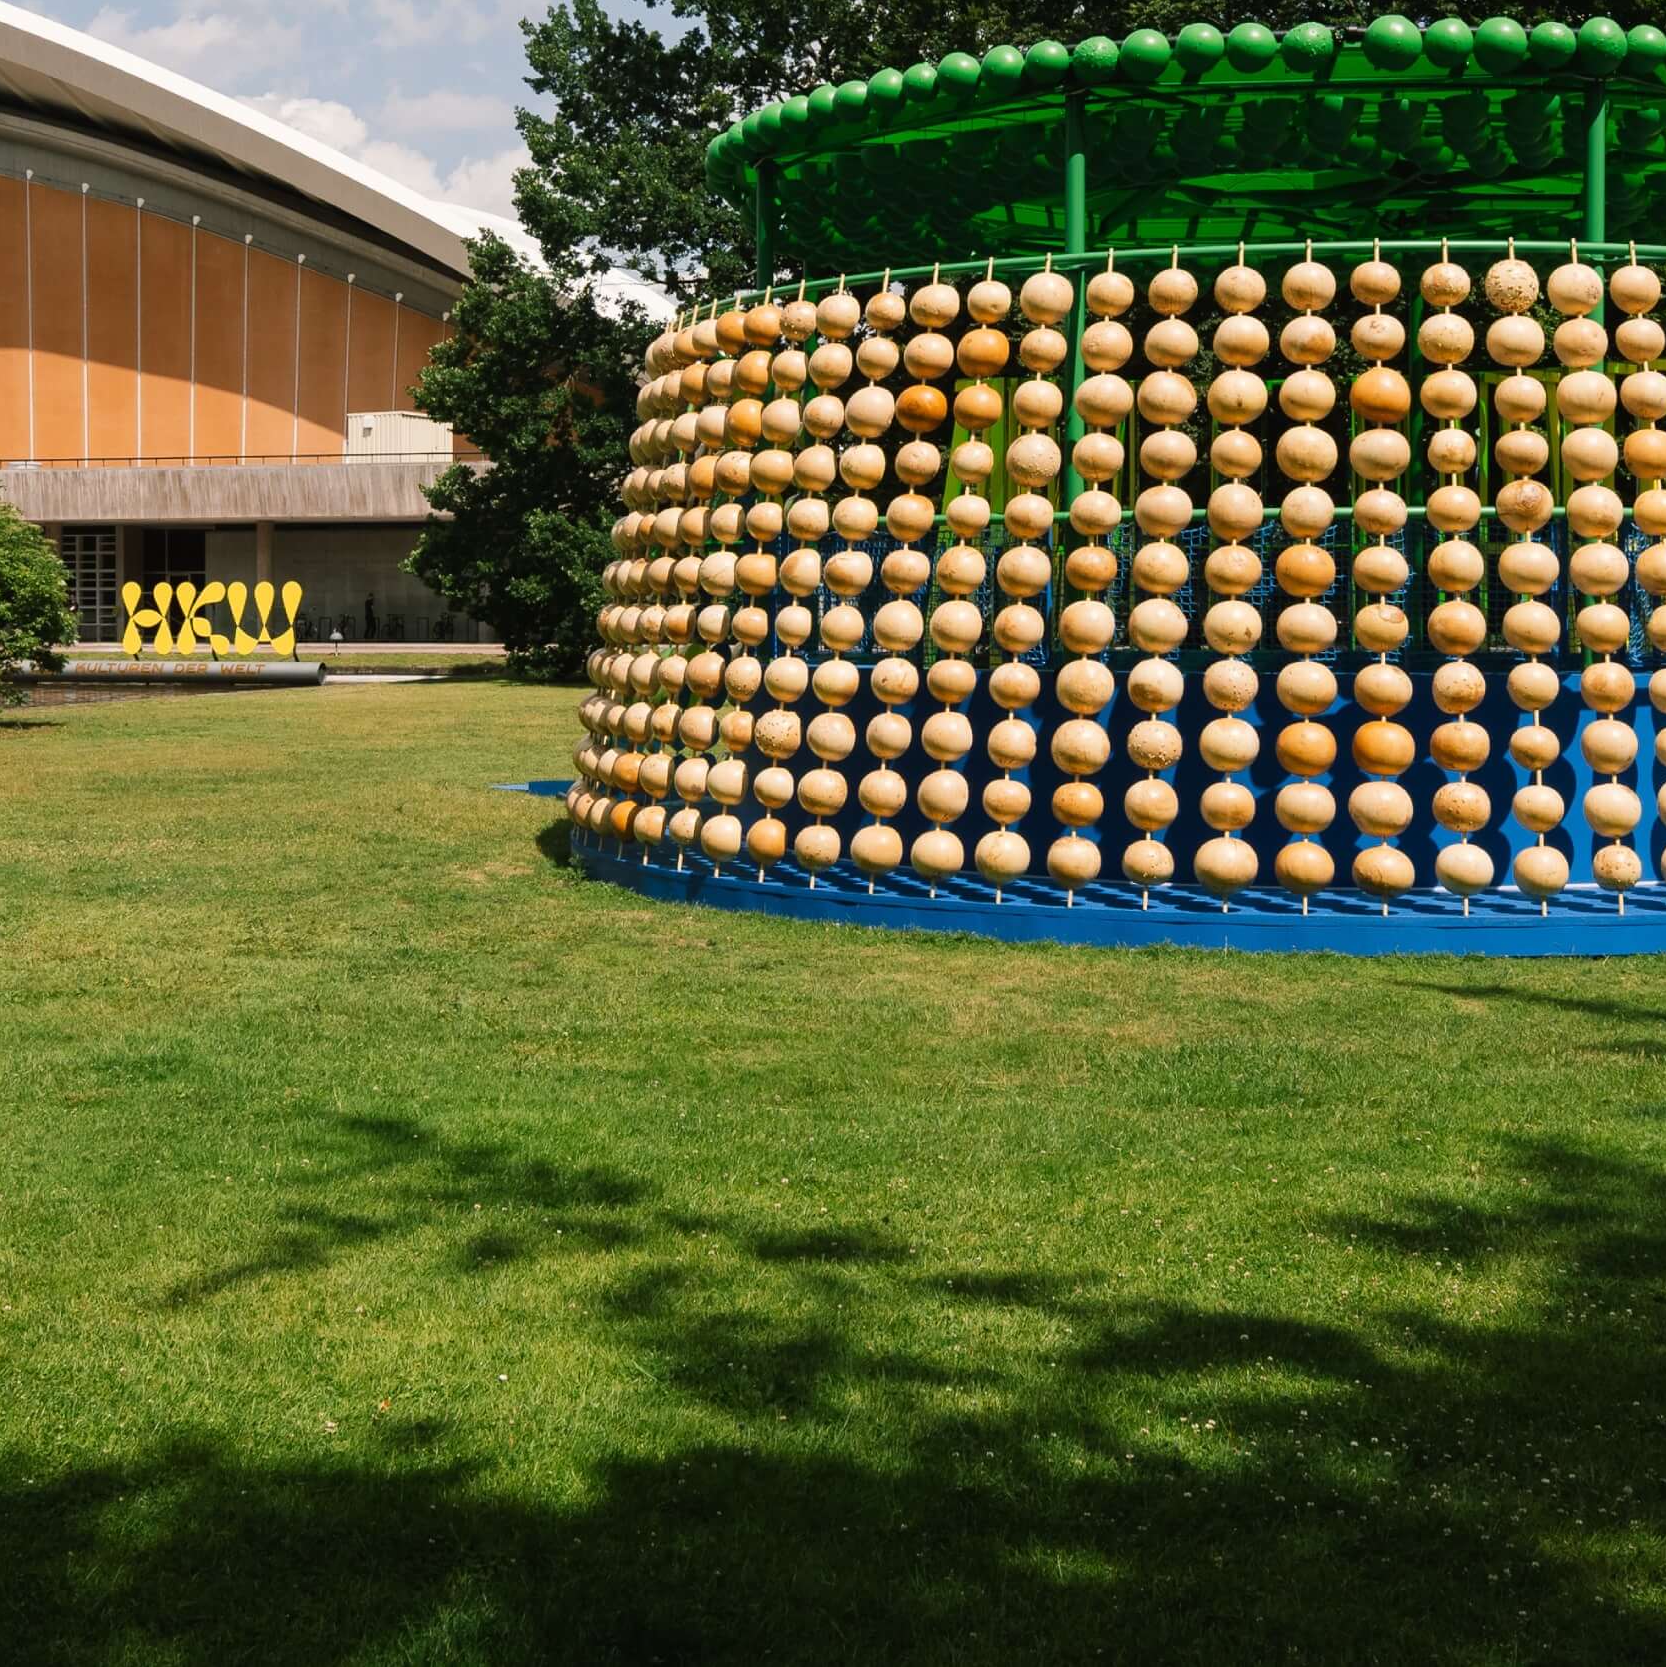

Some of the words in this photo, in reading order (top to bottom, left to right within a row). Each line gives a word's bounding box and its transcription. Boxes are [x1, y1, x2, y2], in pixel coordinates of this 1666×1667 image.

[121, 581, 302, 655] HKW
[76, 662, 164, 674] KULTUREN
[174, 662, 208, 674] DER
[220, 662, 266, 675] WELT
